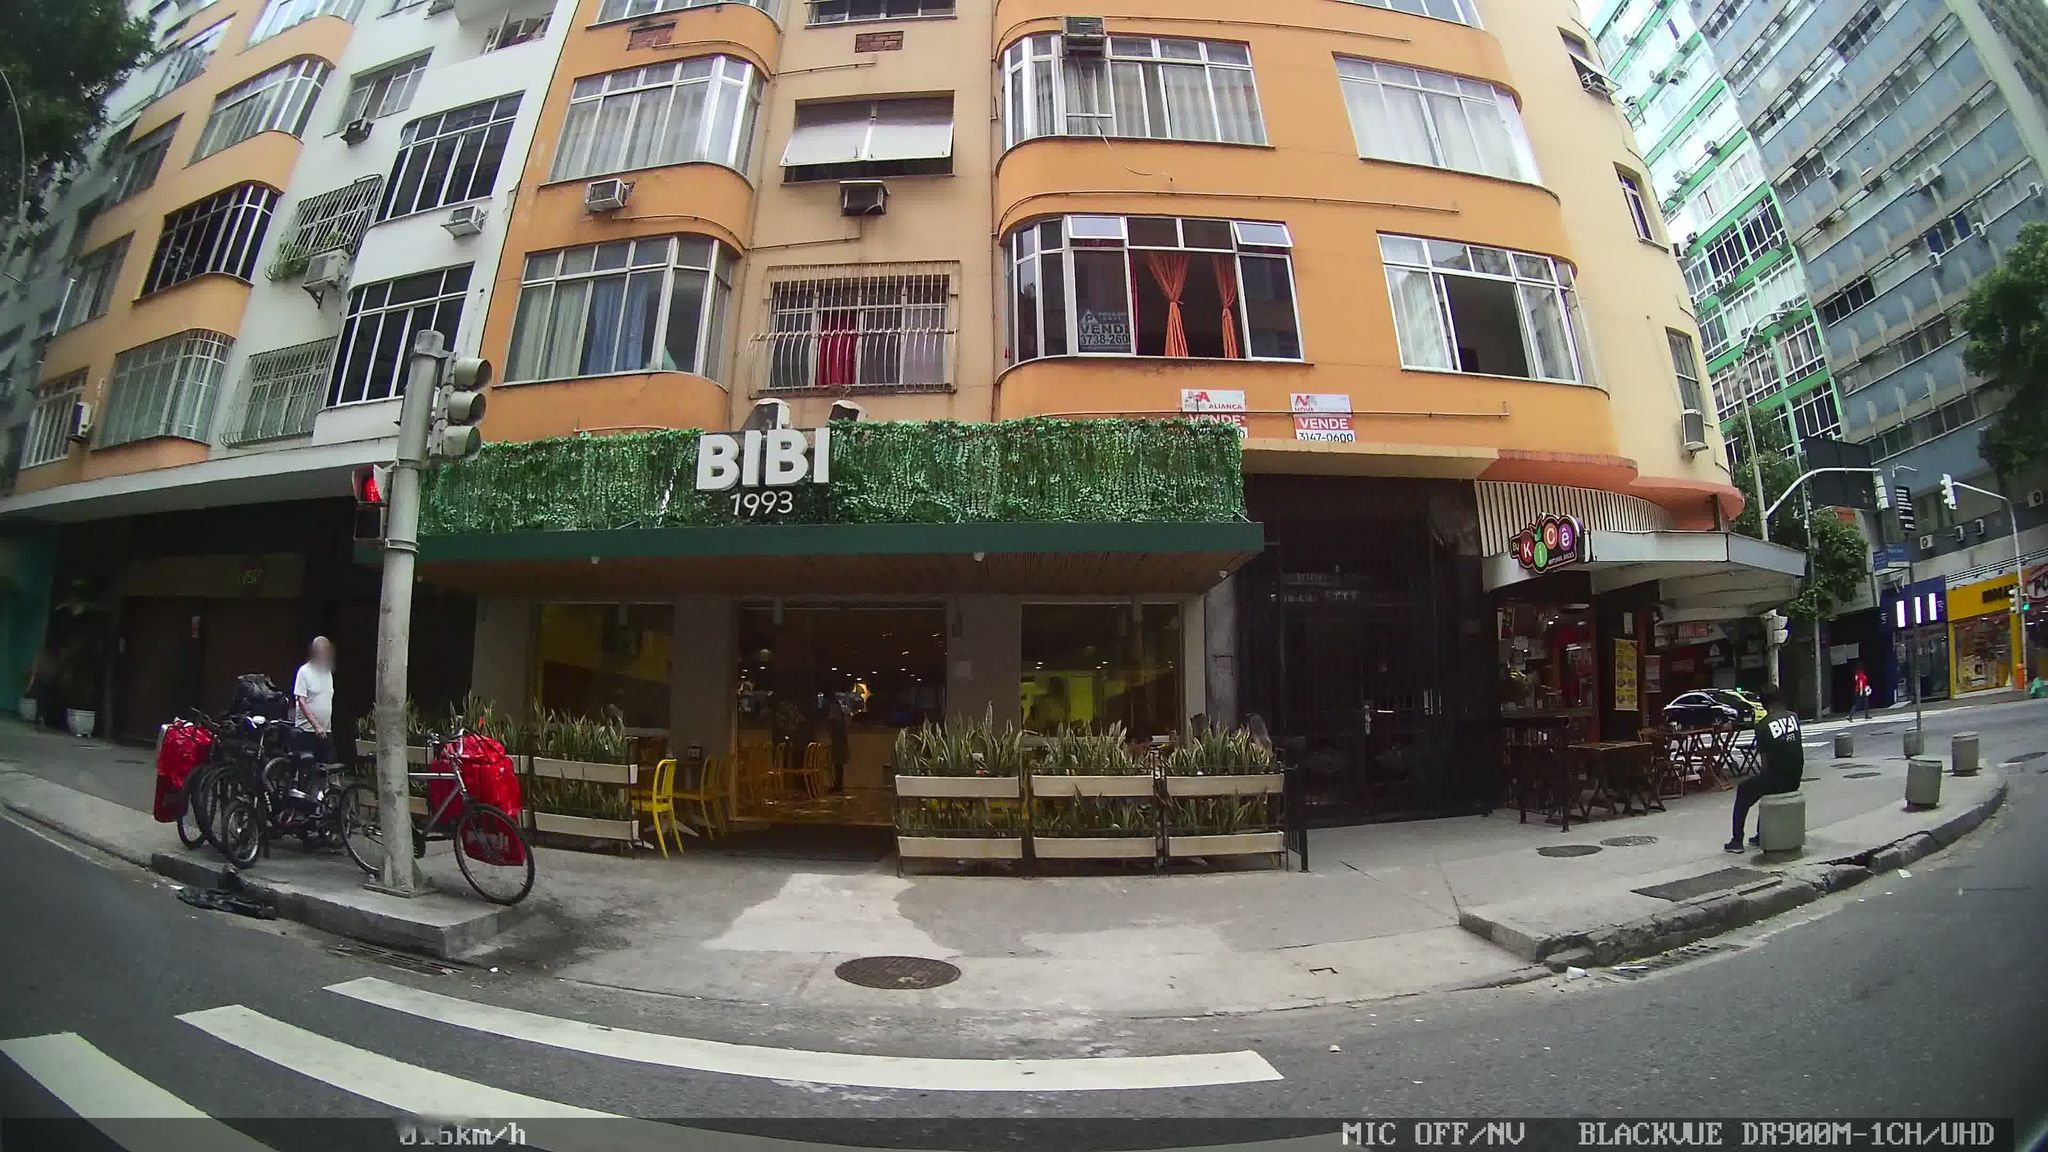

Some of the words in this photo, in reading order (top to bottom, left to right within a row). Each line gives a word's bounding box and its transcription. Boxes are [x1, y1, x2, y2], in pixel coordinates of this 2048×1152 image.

[1299, 417, 1349, 430] VENDE
[1298, 432, 1354, 443] 3147-0600
[696, 427, 831, 491] BIBI
[730, 490, 794, 517] 1993
